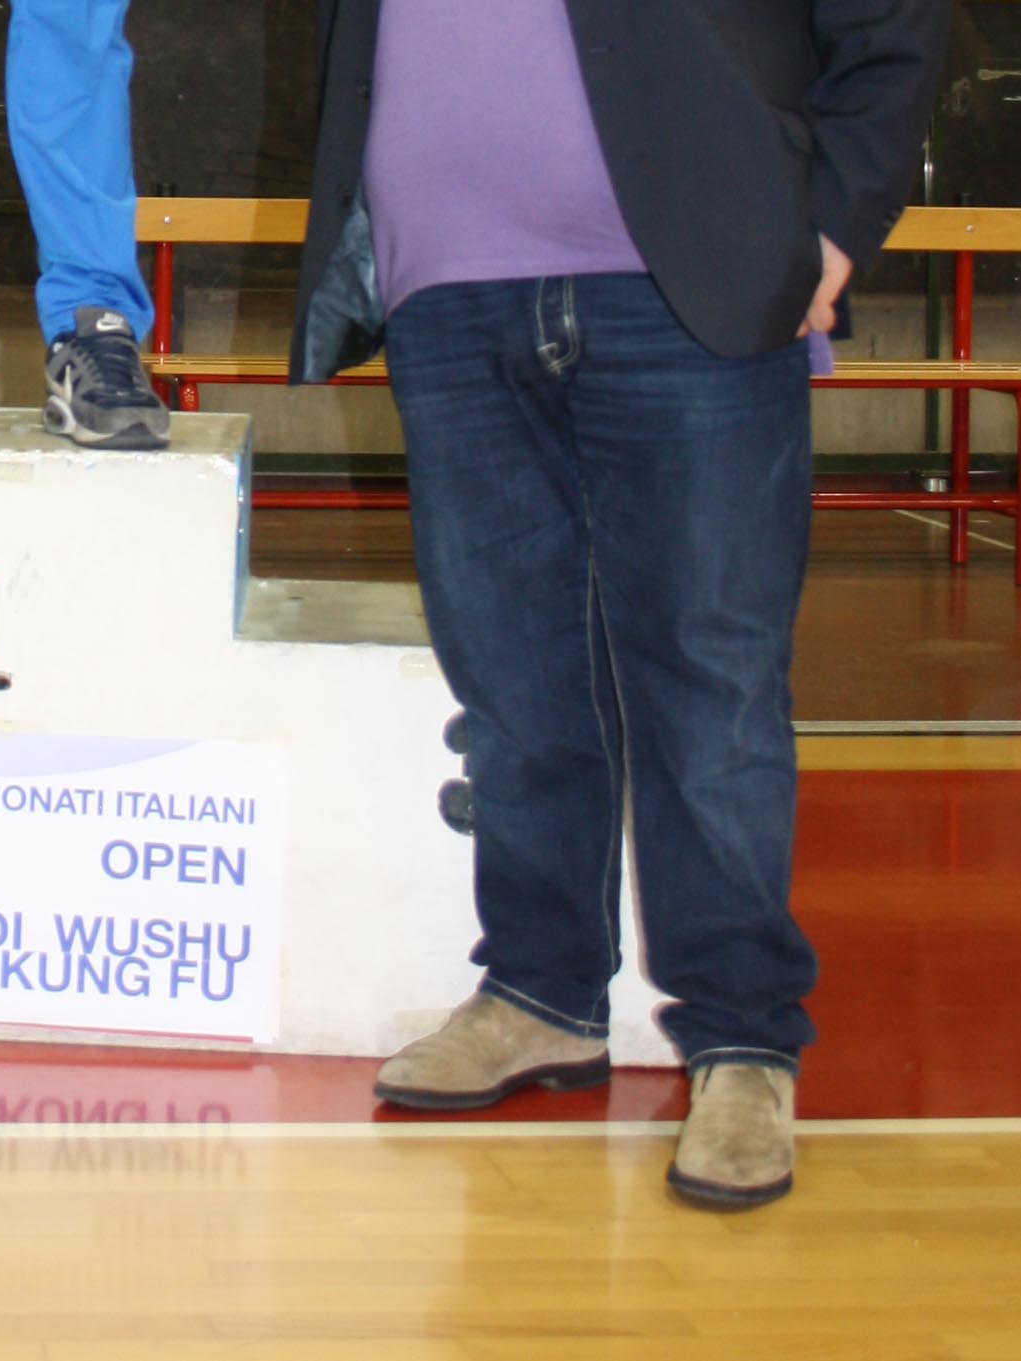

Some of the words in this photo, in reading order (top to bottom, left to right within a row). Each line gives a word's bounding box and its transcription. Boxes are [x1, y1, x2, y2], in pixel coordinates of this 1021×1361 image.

[116, 790, 256, 825] ITALIANI
[101, 839, 247, 887] OPEN
[53, 913, 252, 964] WUSHU
[0, 950, 151, 998] KUNG
[169, 959, 236, 1002] FU
